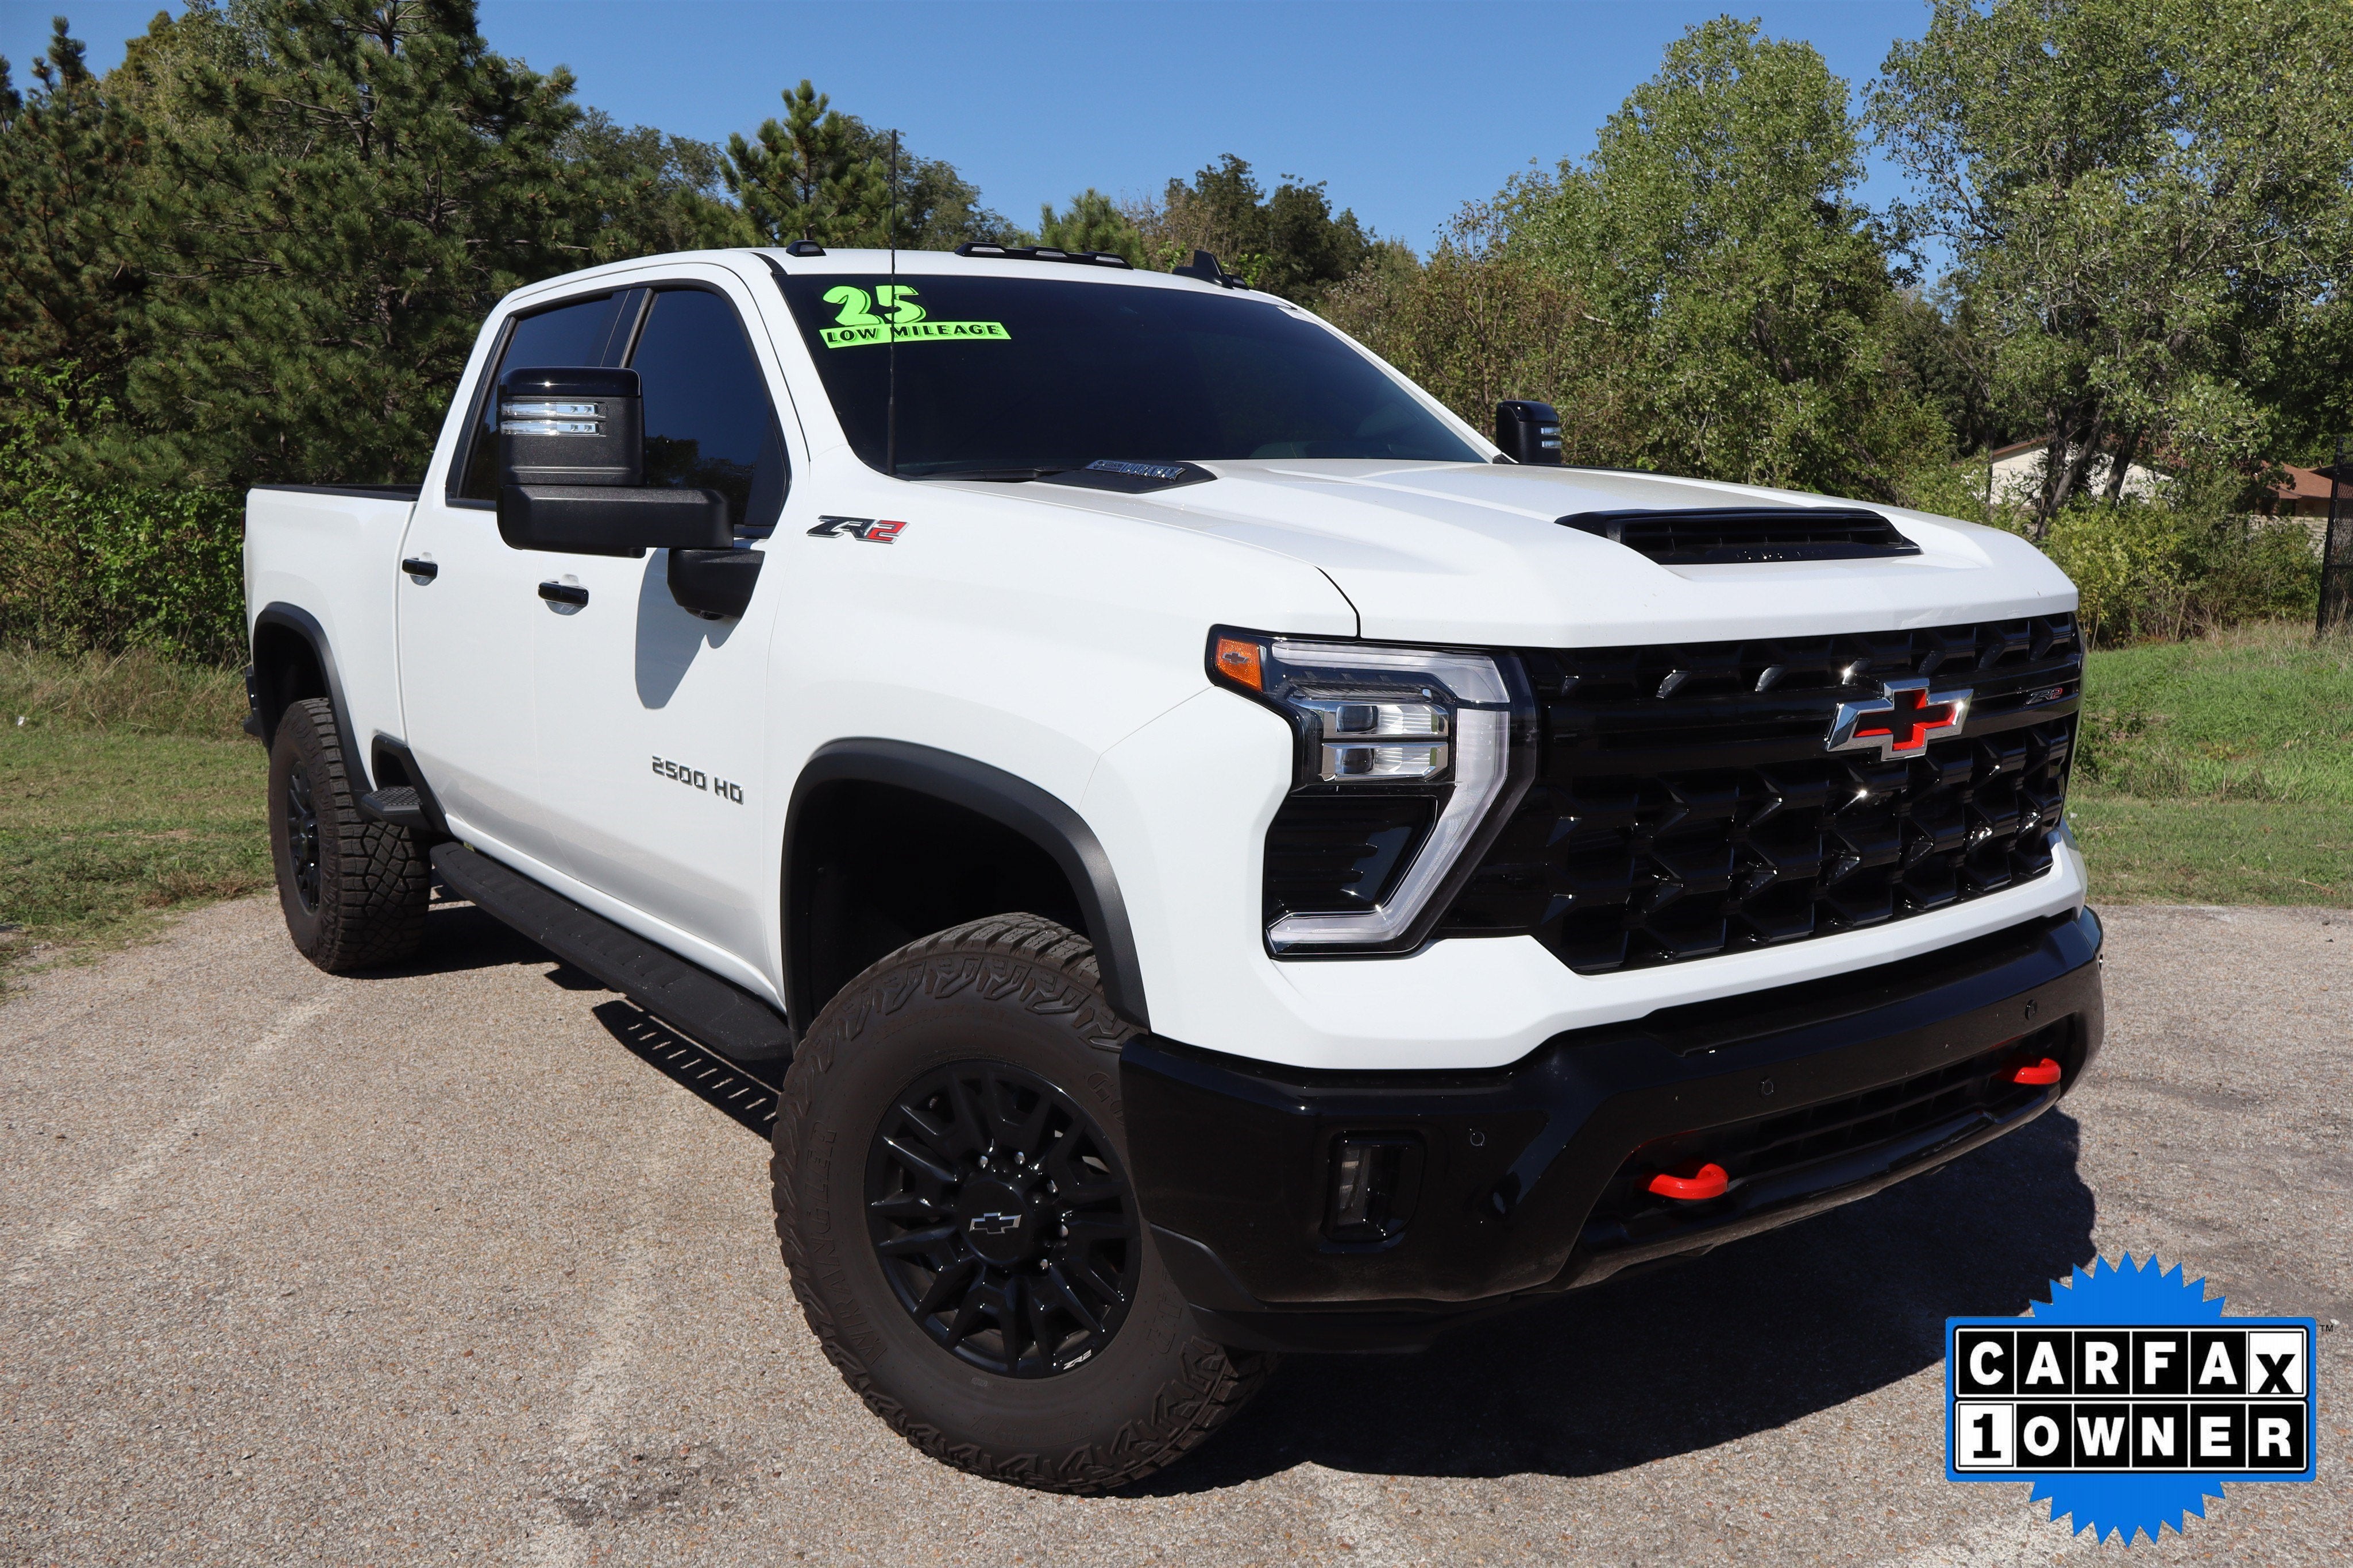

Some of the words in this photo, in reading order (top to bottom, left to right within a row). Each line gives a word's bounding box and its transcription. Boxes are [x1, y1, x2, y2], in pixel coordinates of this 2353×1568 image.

[823, 285, 926, 325] 25
[827, 327, 879, 343] LOW
[890, 325, 1000, 338] MILEAGE
[806, 515, 910, 544] ZR2
[652, 754, 708, 791] 2500
[714, 774, 744, 805] HD
[1063, 1349, 1091, 1370] ZR2
